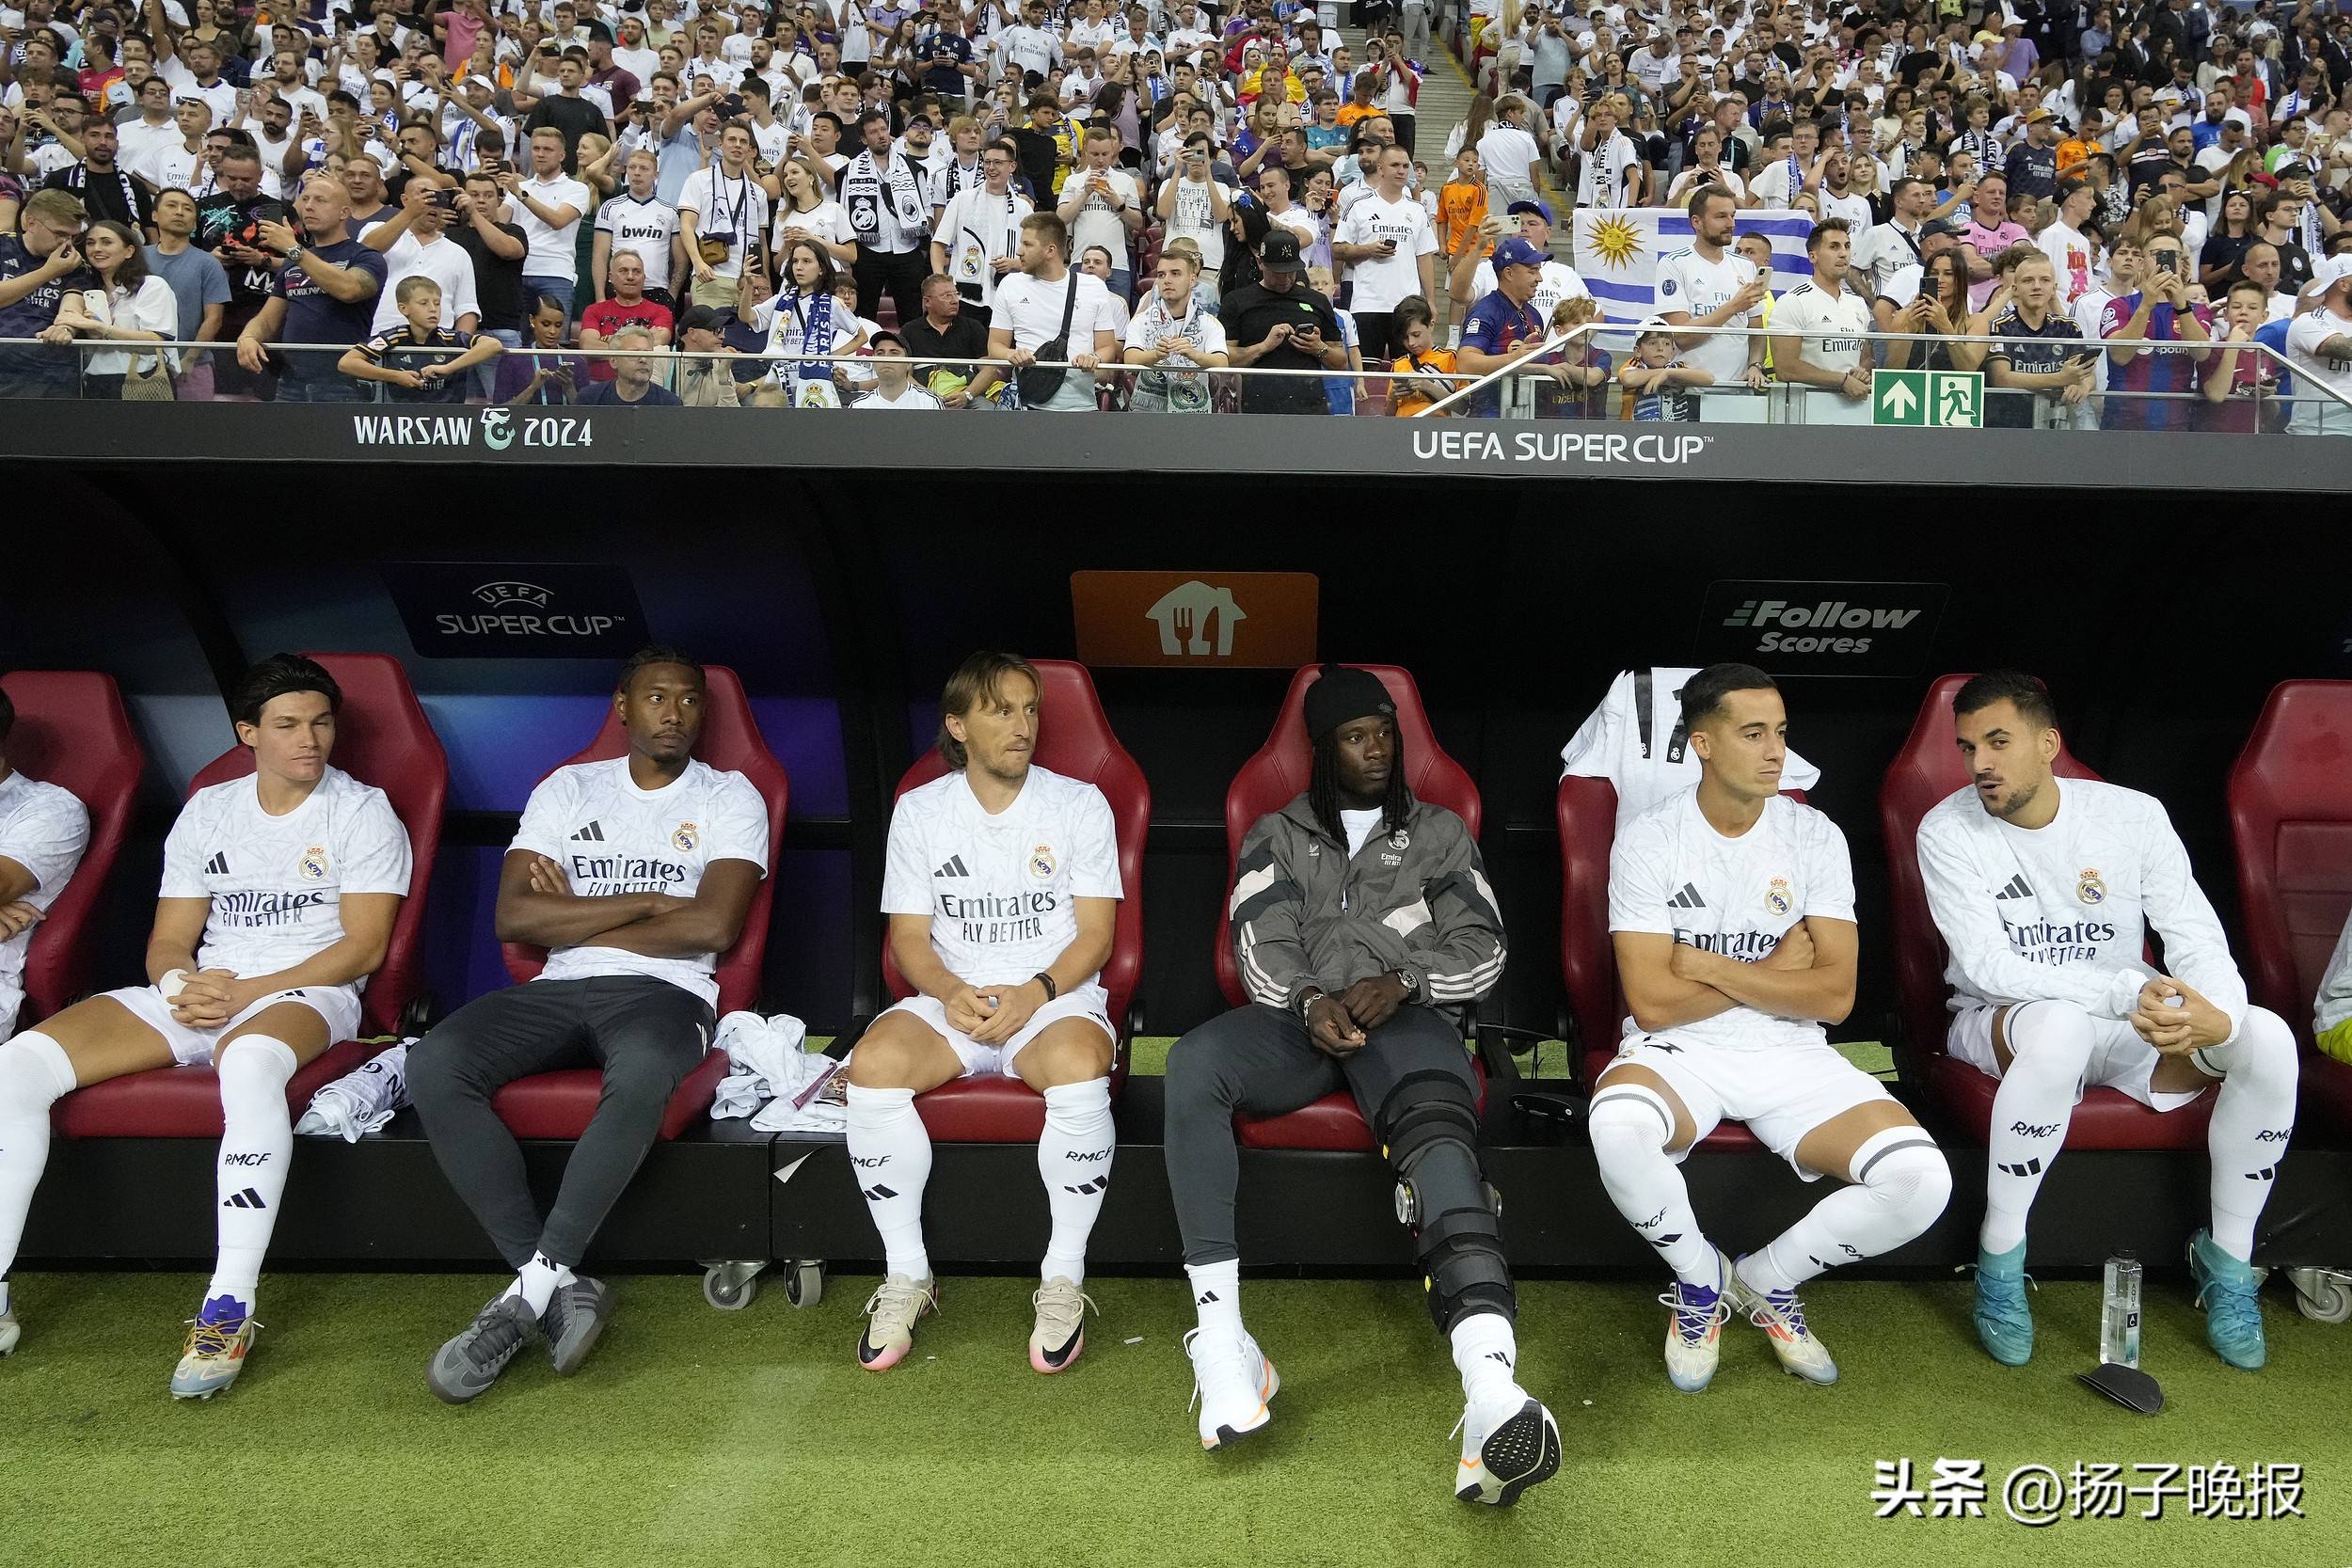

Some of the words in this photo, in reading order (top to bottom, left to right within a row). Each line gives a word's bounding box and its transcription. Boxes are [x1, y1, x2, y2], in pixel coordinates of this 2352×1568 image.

[1020, 46, 1046, 57] Emirates
[622, 226, 662, 240] bwin
[1372, 223, 1413, 235] Emirates
[354, 416, 472, 445] WARSAW
[524, 418, 594, 446] 2024
[1413, 431, 1505, 460] UEFA
[477, 586, 547, 604] UEFA
[1751, 600, 1921, 628] Follow
[1756, 631, 1872, 654] Scores
[572, 854, 686, 882] Emirates
[1381, 852, 1402, 862] Emira
[212, 889, 325, 913] Emirates
[941, 891, 1057, 919] Emirates
[962, 921, 983, 943] FLY
[989, 917, 1043, 943] BETTER
[2004, 916, 2115, 946] Emirates
[2010, 1120, 2061, 1138] RMCF
[225, 1152, 272, 1167] RMCF
[1065, 1144, 1113, 1163] RMCF
[1630, 1206, 1667, 1229] MCF
